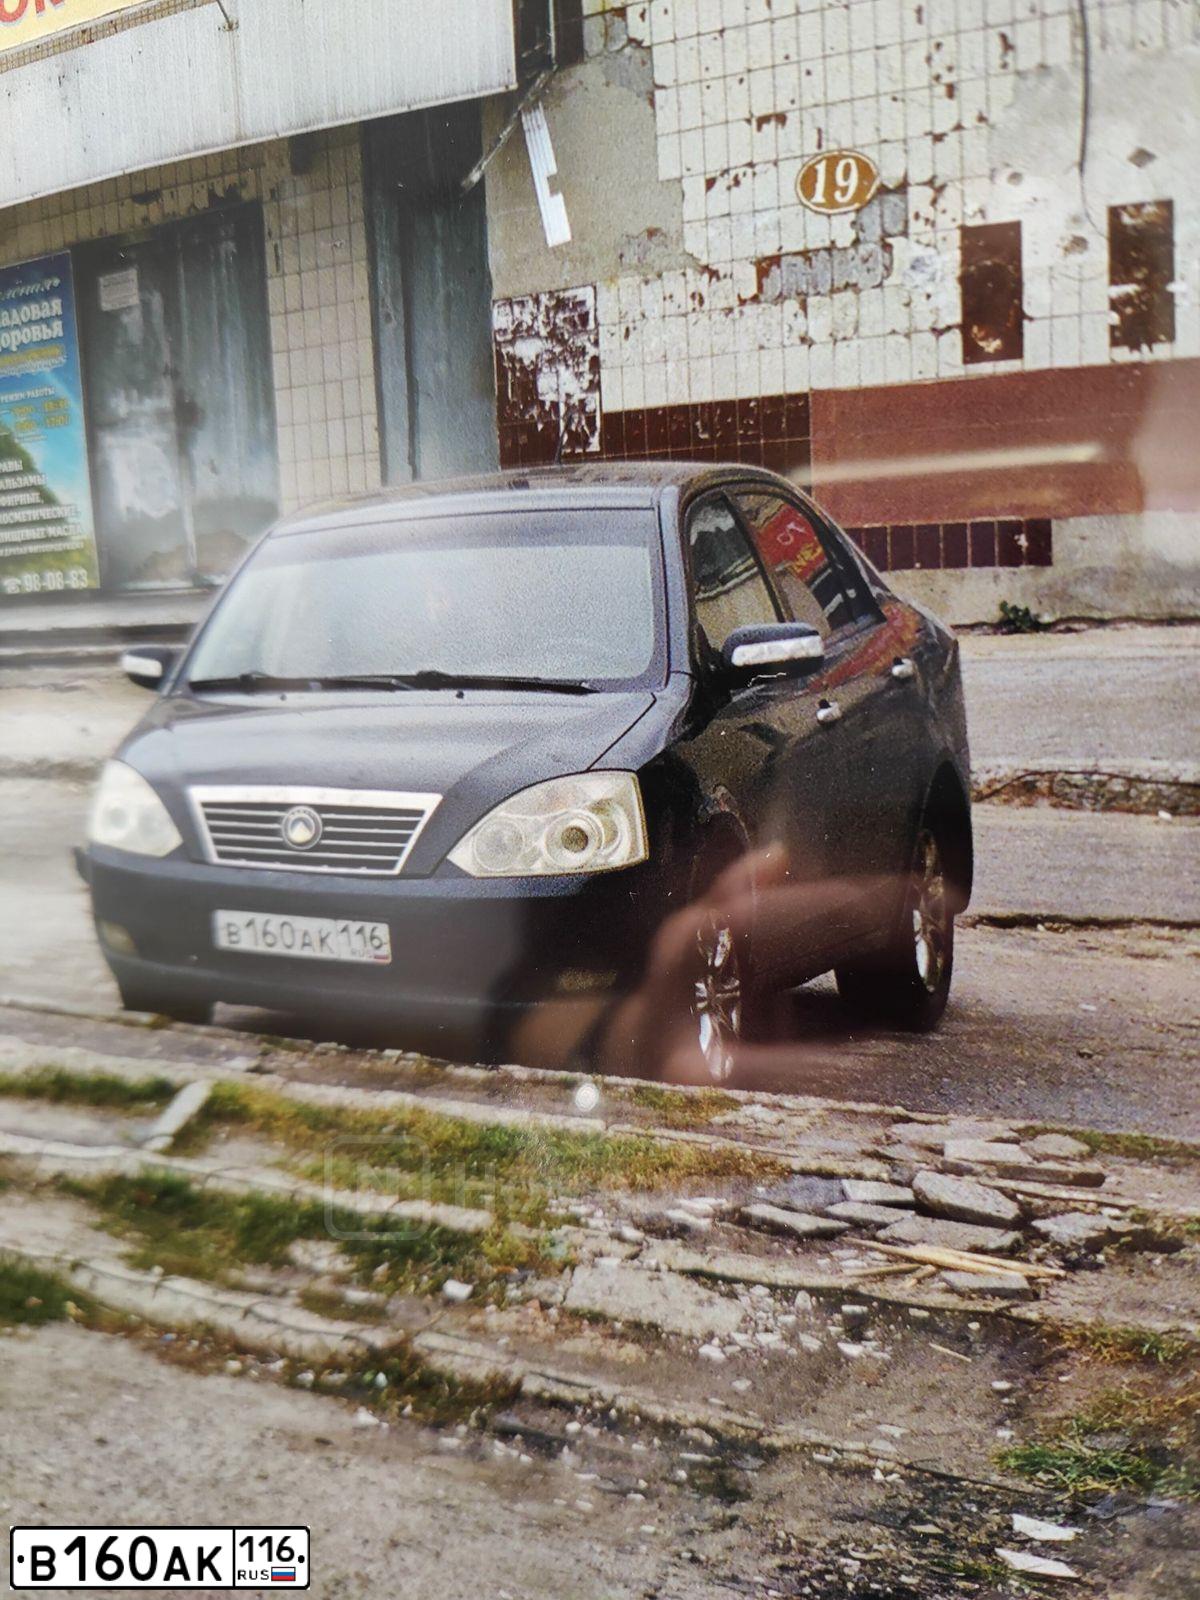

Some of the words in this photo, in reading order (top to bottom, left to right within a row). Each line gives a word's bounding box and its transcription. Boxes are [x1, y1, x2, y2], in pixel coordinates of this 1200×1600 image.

[809, 158, 859, 203] 19
[0, 299, 63, 329] адовая
[0, 320, 64, 352] оровья
[24, 567, 88, 592] 98-08-83
[339, 924, 384, 950] 116
